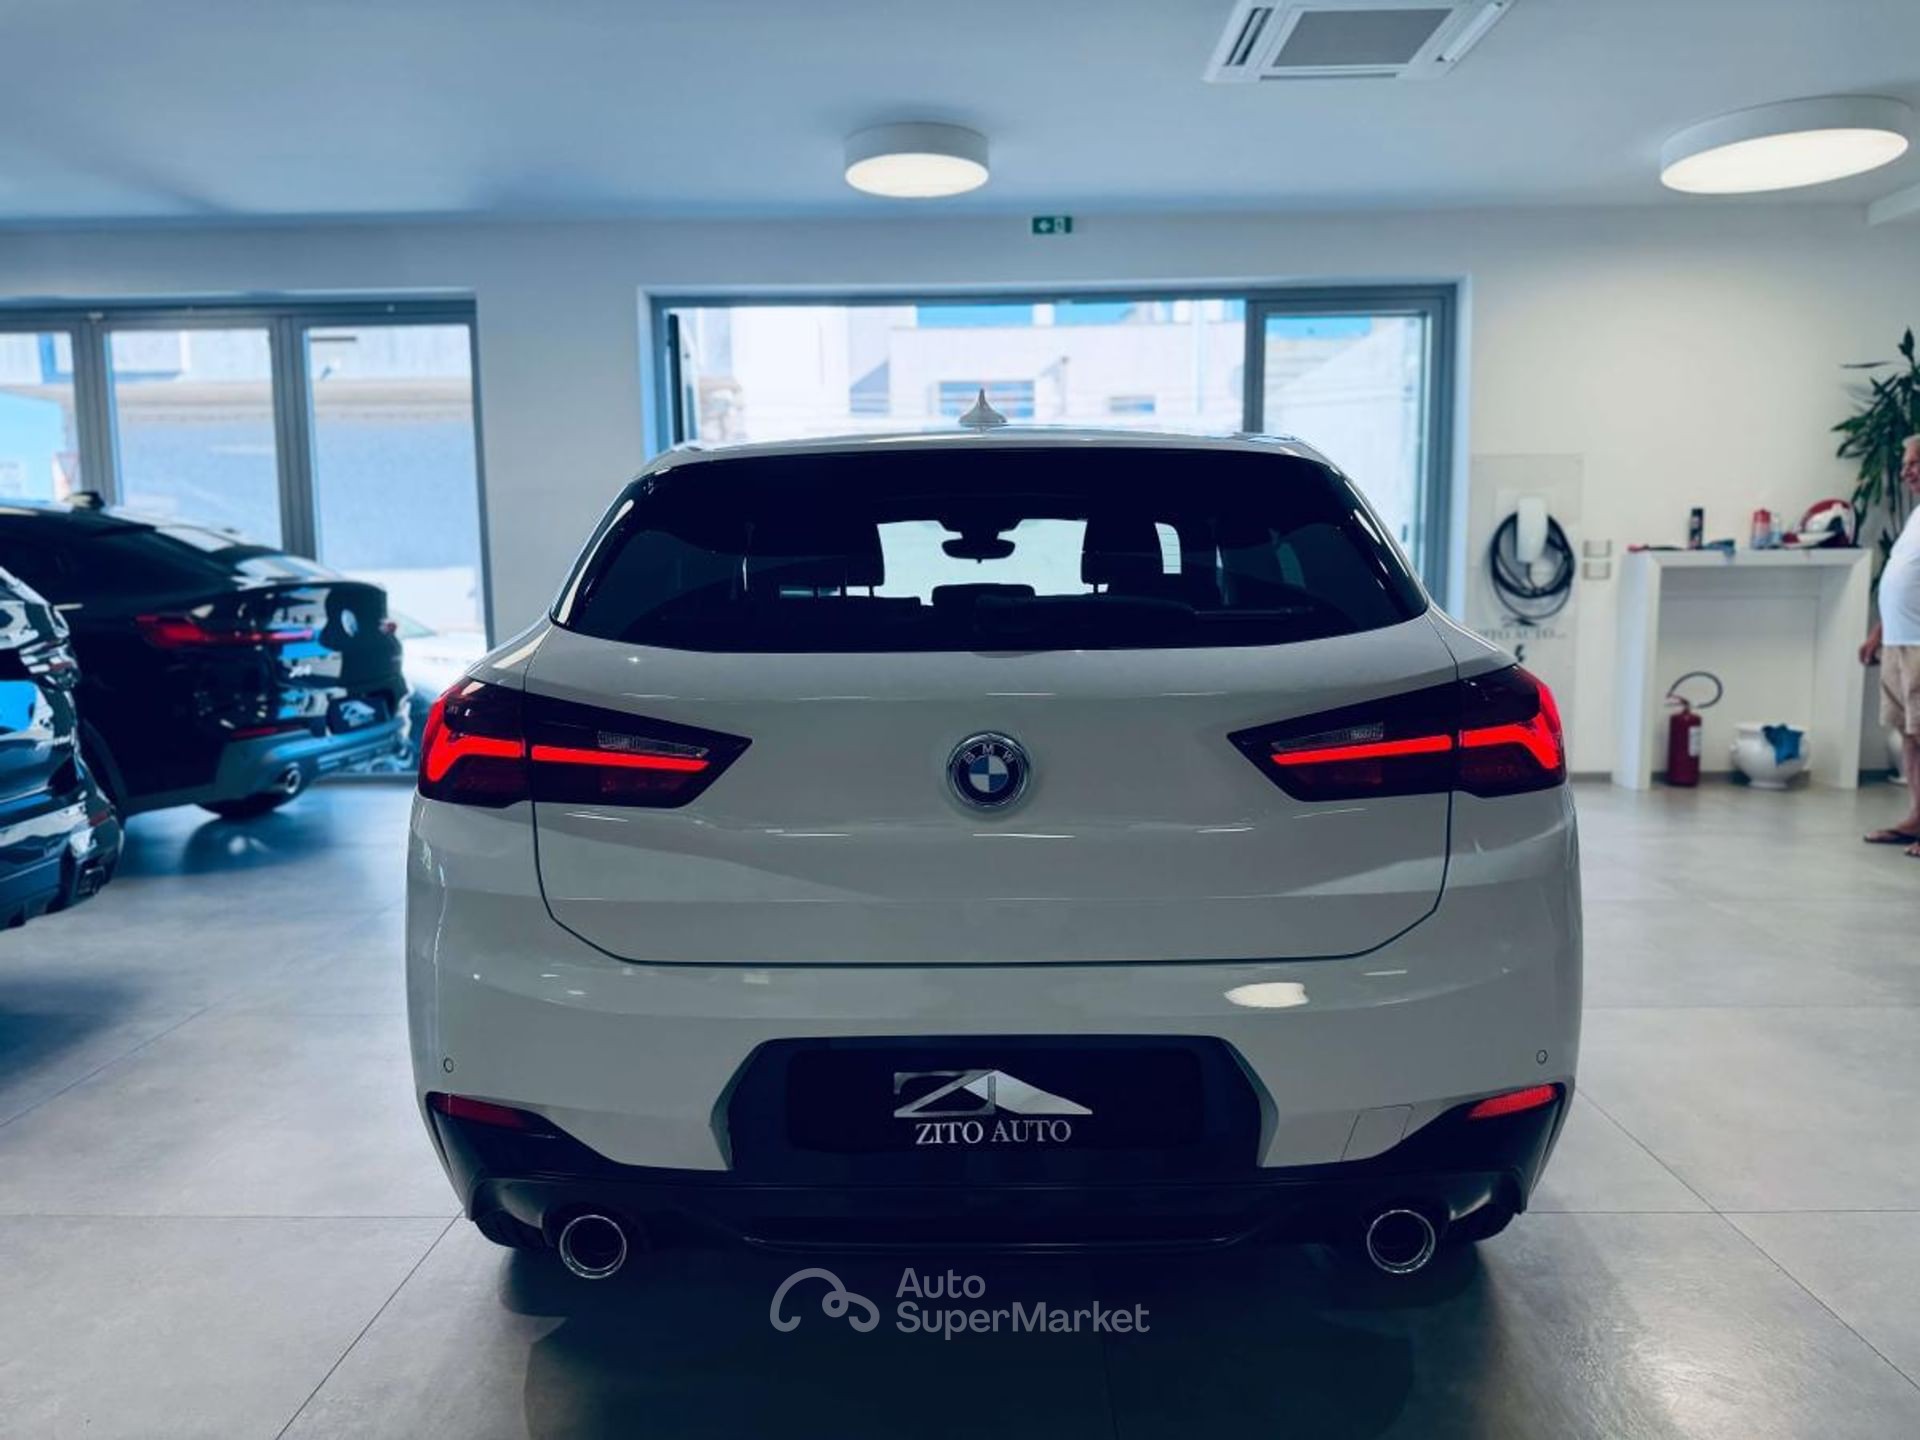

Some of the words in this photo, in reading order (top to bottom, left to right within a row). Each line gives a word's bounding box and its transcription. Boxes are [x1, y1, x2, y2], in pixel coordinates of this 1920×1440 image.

[962, 743, 1016, 764] BMW
[915, 1121, 984, 1145] ZITO
[991, 1119, 1072, 1143] AUTO
